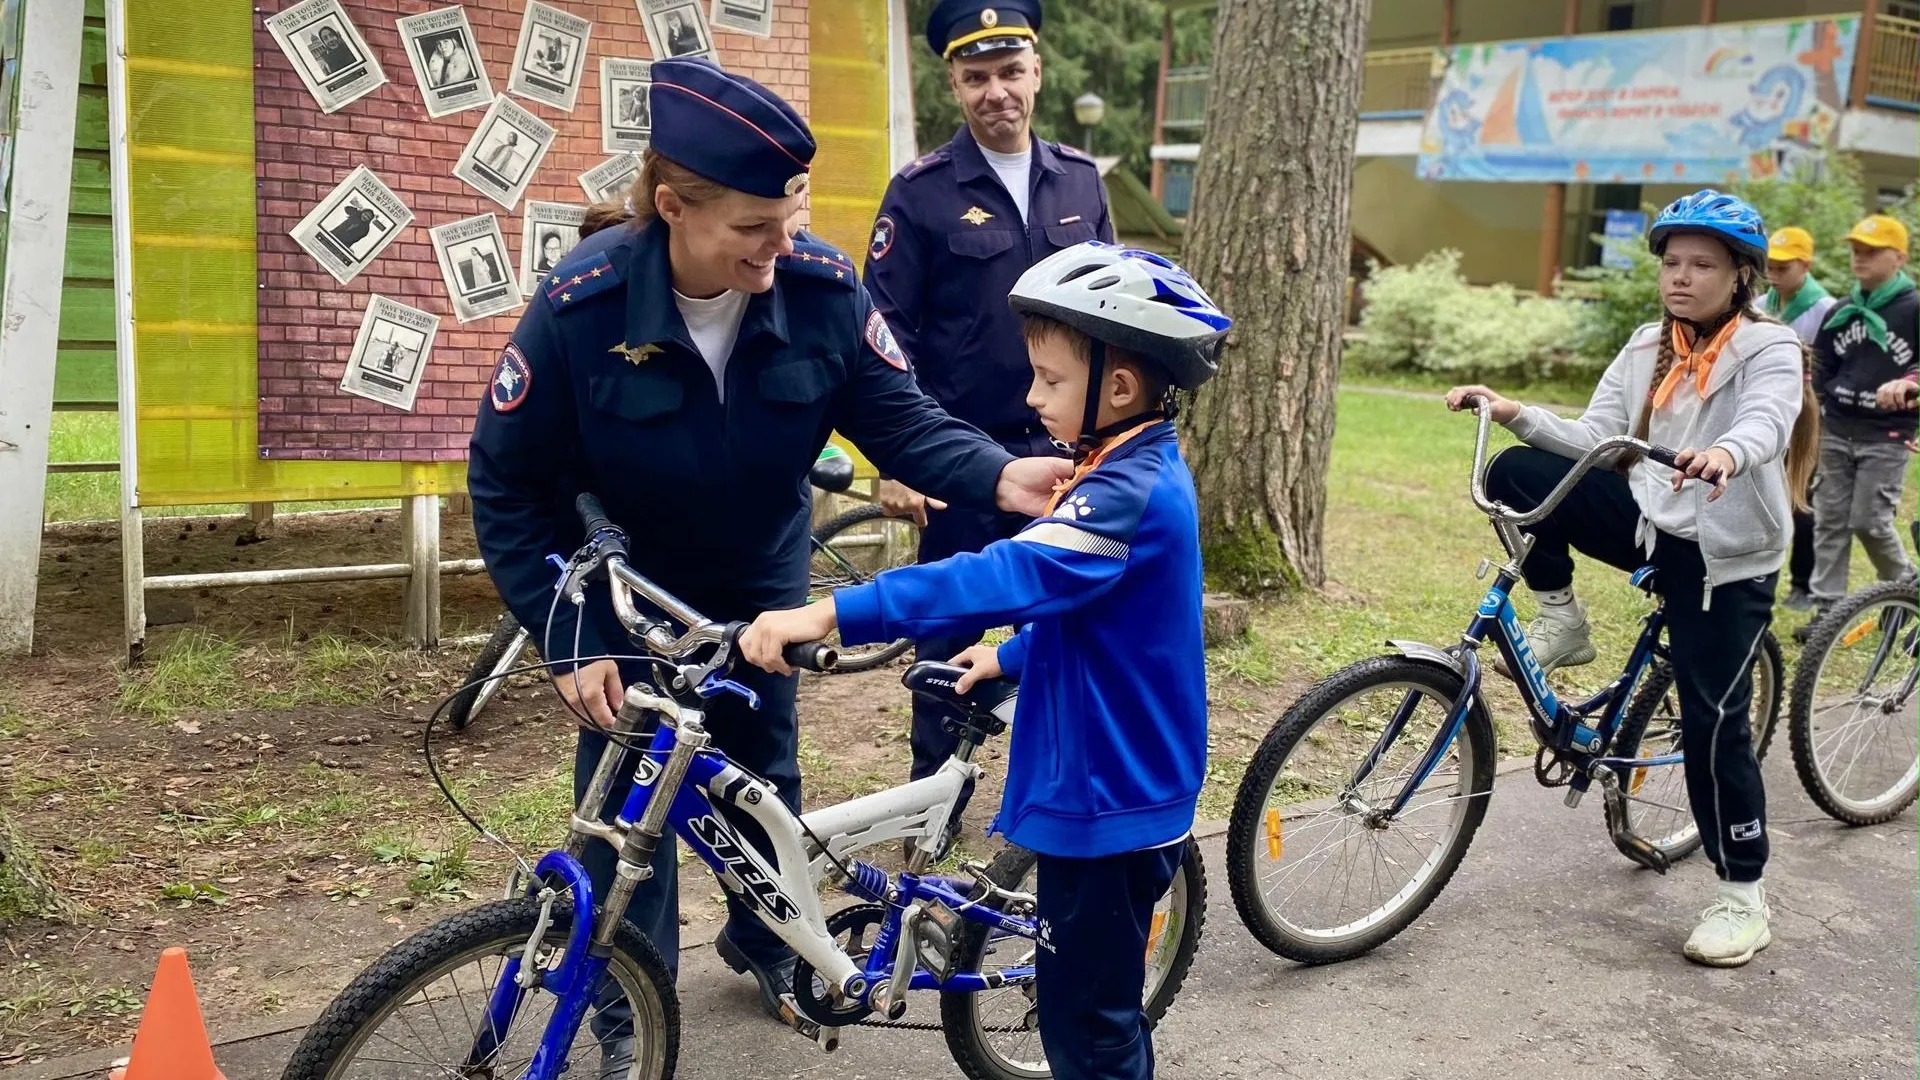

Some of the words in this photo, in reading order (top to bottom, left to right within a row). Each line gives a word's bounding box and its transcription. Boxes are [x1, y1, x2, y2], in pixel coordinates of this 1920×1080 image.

[277, 13, 296, 26] HAVE
[296, 5, 311, 16] YOU
[408, 20, 426, 28] HAVE
[427, 15, 441, 23] YOU
[284, 20, 300, 30] THIS
[361, 183, 375, 197] THIS
[361, 176, 378, 192] HAVE
[379, 190, 392, 203] YOU
[392, 203, 406, 217] SEEN
[440, 228, 458, 237] HAVE
[460, 223, 473, 231] YOU
[474, 219, 490, 227] SEEN
[445, 234, 460, 242] THIS
[379, 302, 396, 312] HAVE
[400, 310, 414, 318] YOU
[415, 315, 432, 324] SEEN
[381, 309, 396, 319] THIS
[1507, 616, 1549, 699] STELS
[925, 677, 957, 688] STELS
